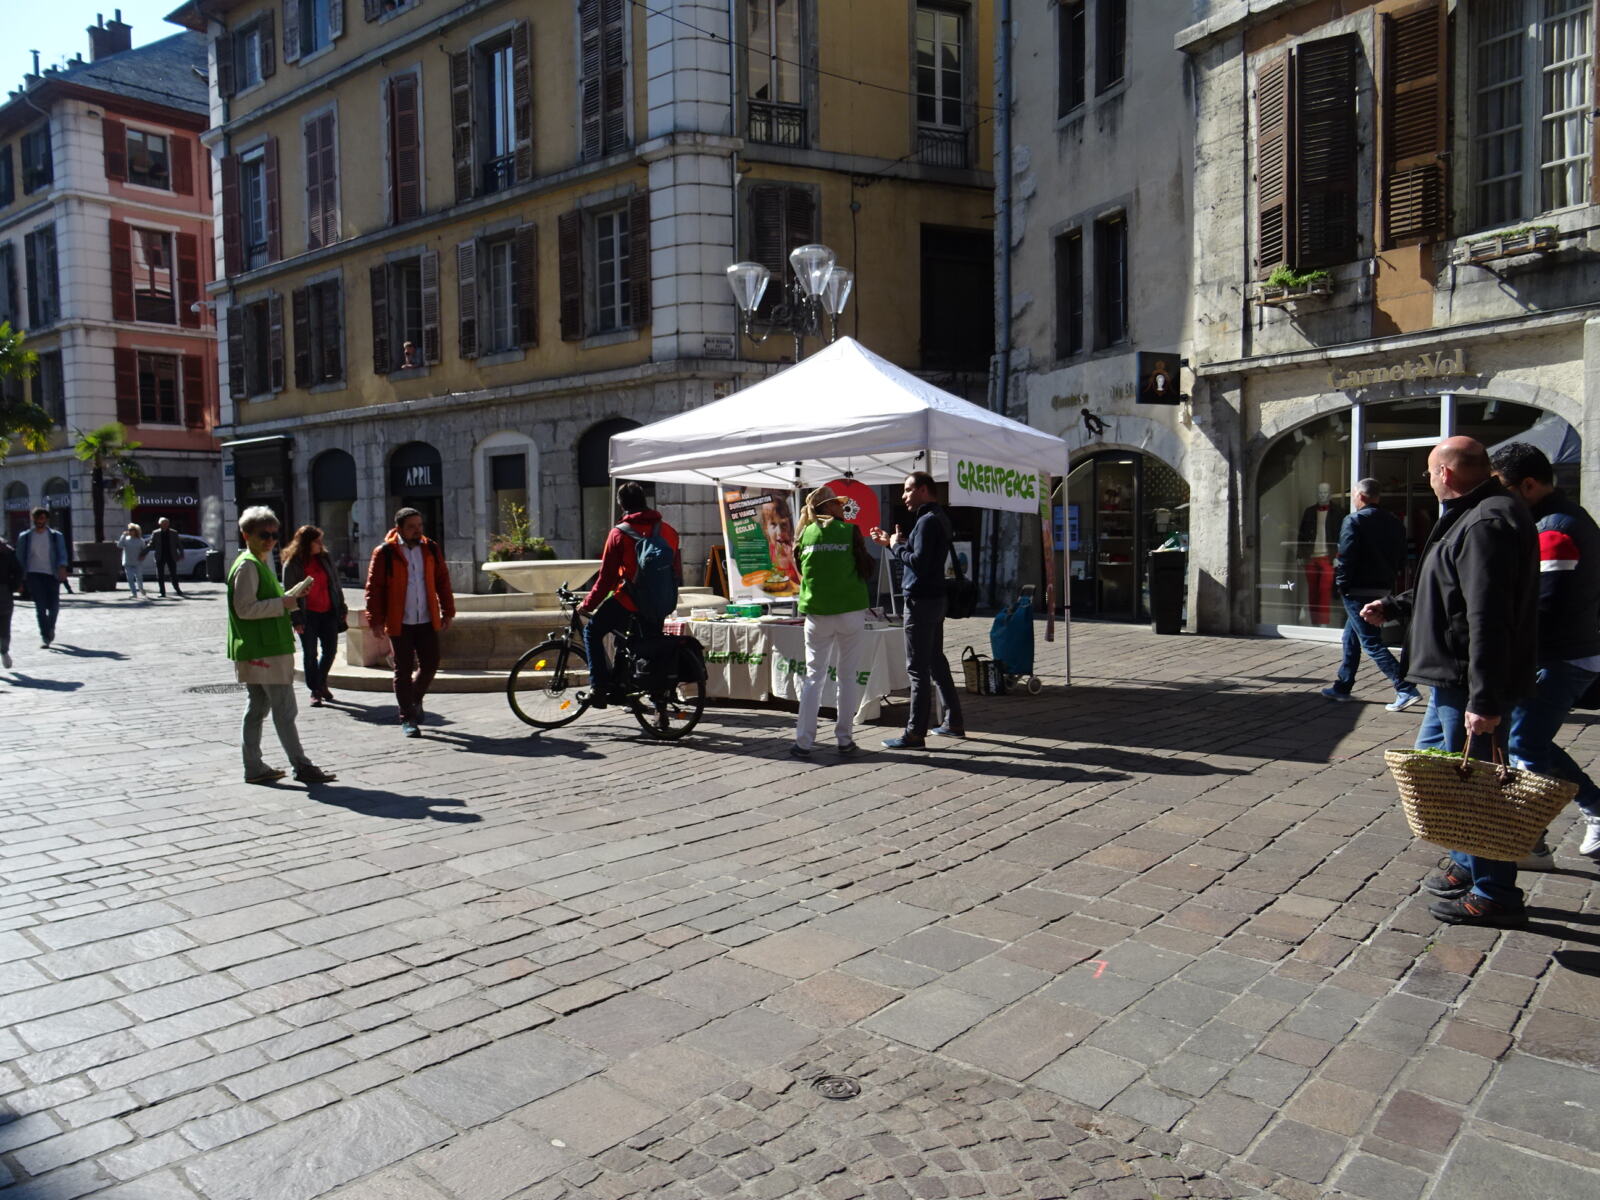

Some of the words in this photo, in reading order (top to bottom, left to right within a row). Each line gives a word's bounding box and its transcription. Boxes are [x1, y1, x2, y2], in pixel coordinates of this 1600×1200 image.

[1419, 349, 1466, 377] Vol
[405, 466, 432, 486] APRIL
[957, 459, 1036, 499] GREENPEACE
[175, 495, 199, 505] d'Or
